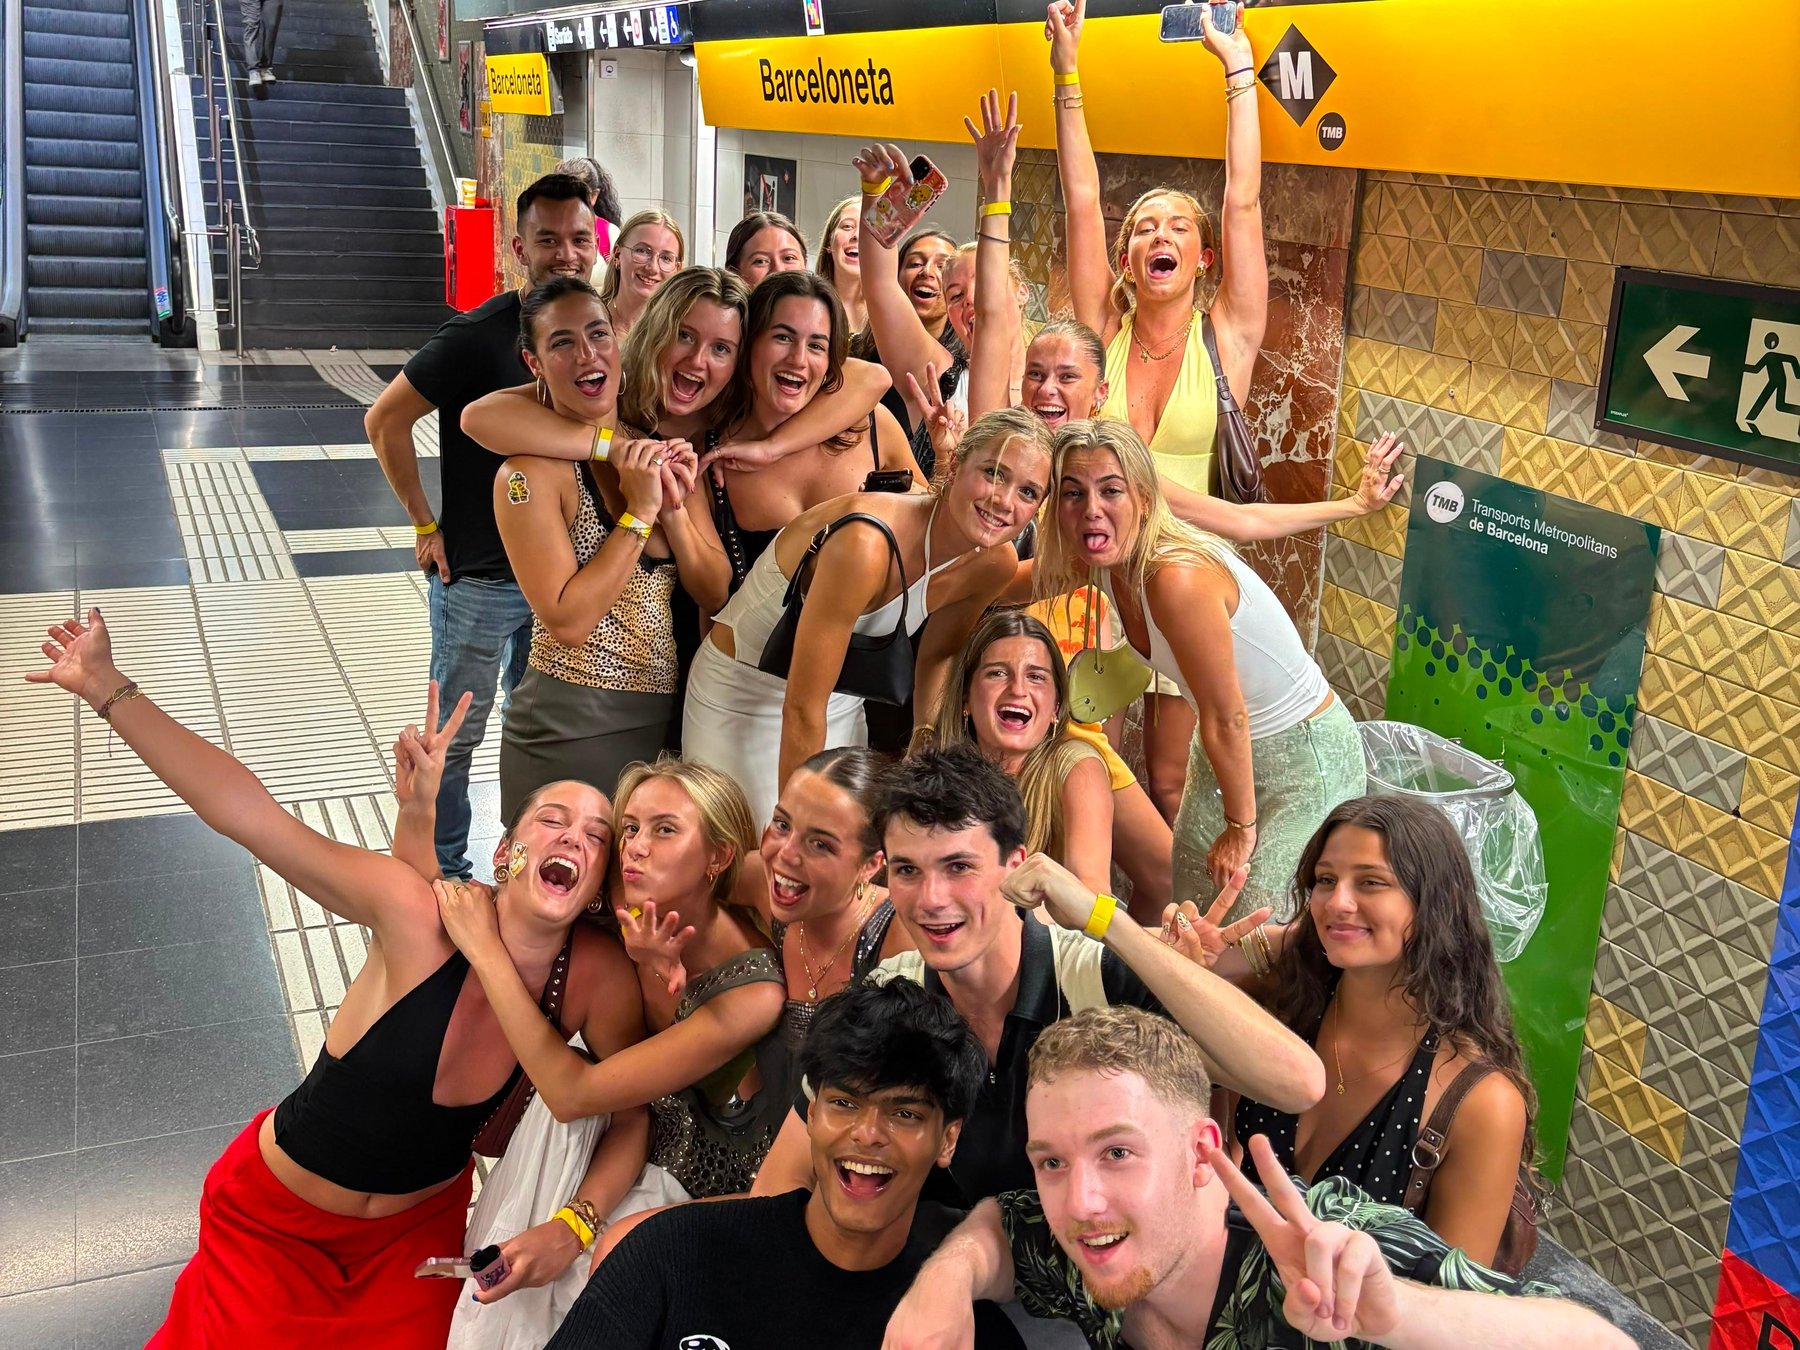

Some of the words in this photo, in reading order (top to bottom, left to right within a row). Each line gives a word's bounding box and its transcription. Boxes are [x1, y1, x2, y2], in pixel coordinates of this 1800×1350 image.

[490, 66, 542, 95] Barceloneta
[759, 57, 895, 105] Barceloneta
[1278, 51, 1314, 100] M
[1321, 126, 1343, 139] TMB
[1432, 494, 1459, 513] TMB
[1469, 517, 1484, 533] de
[1486, 522, 1549, 555] Barcelona
[1471, 498, 1531, 531] Transports
[1533, 518, 1618, 559] Metropolitans
